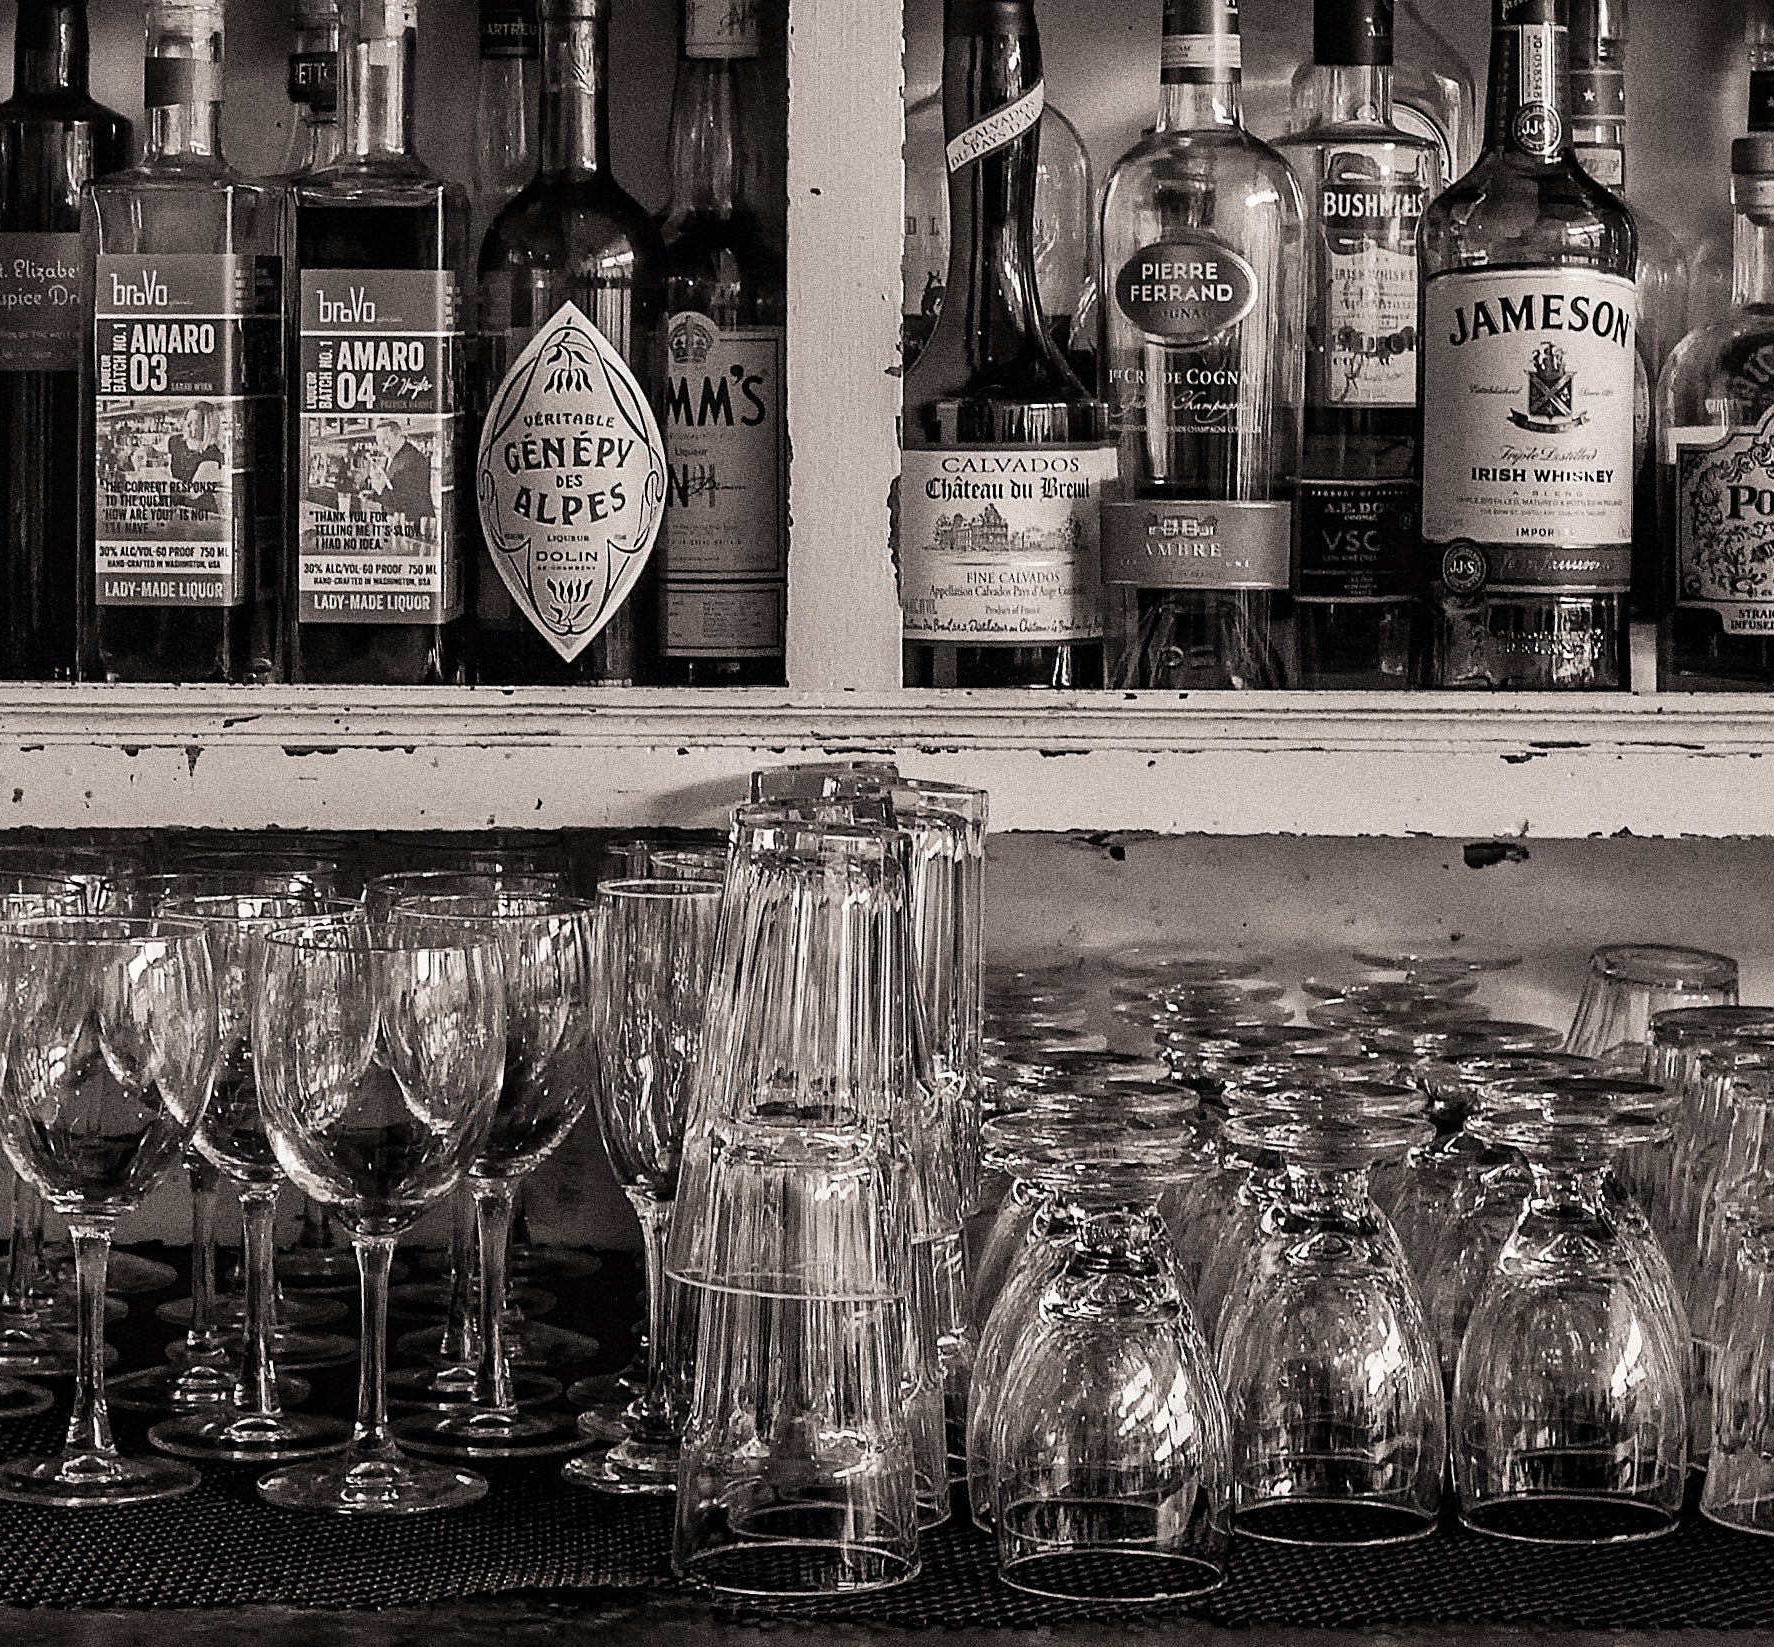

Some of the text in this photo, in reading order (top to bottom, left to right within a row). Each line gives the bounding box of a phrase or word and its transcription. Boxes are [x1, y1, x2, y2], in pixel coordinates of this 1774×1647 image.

[952, 132, 1006, 168] DU PAYS
[1323, 193, 1423, 217] BUSHMILLS
[14, 259, 78, 283] Elizabe
[1142, 263, 1218, 280] PIERRE
[1130, 284, 1233, 302] FERRAND
[1450, 295, 1629, 347] JAMESON
[130, 324, 214, 354] AMARO
[337, 341, 424, 372] AMARO
[130, 354, 167, 392] 03
[337, 372, 375, 410] 04
[524, 412, 614, 428] VÉRITABLE
[504, 431, 634, 474] GÉNÉPY
[941, 457, 1079, 473] CALVADOS
[556, 475, 583, 489] DES
[1472, 468, 1614, 483] IRISH WHISKEY
[926, 476, 1003, 501] Château
[1011, 479, 1033, 499] du
[514, 482, 626, 526] ALPES
[349, 511, 368, 523] YOU
[370, 511, 387, 523] FOR
[315, 524, 353, 536] TELLING
[356, 525, 370, 536] ME
[99, 546, 117, 557] 30%
[169, 546, 195, 557] PROOF
[201, 546, 215, 557] 750
[321, 538, 340, 550] HAD
[343, 538, 356, 550] NO
[536, 552, 598, 562] DOLIN
[304, 563, 438, 575] 30% PROOF 750 ML
[967, 572, 1060, 583] FINE CALVADOS
[105, 581, 223, 600] LADY-MADE LIQUOR
[930, 585, 973, 598] Appellation
[975, 585, 1010, 596] Calvados
[1013, 587, 1029, 598] Pays
[314, 594, 430, 612] LADY-MADE LIQUOR
